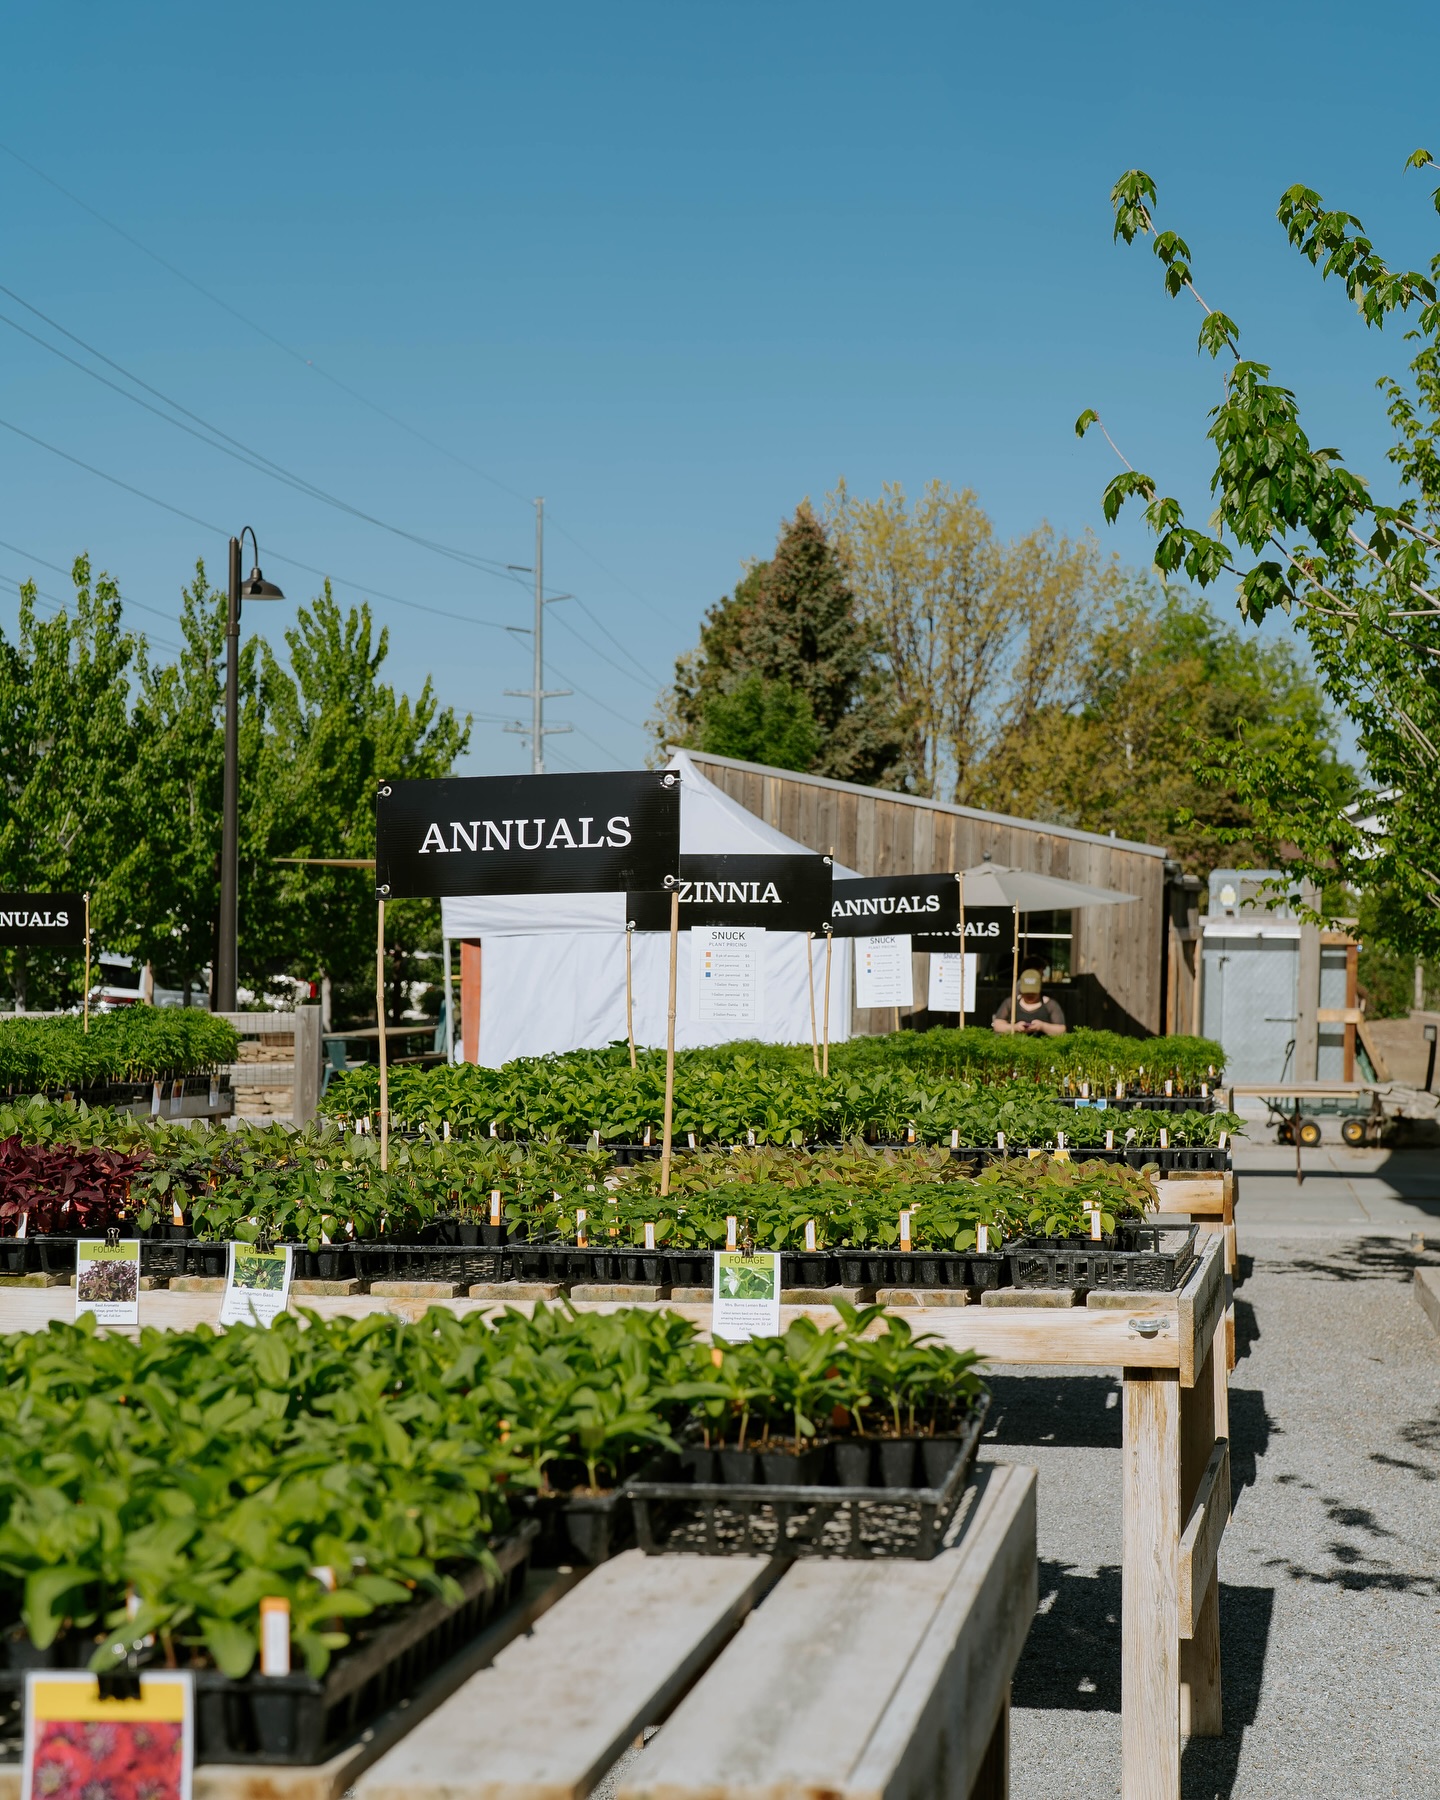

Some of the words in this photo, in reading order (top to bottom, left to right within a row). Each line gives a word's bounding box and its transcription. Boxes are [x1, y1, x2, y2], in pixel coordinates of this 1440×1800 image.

[418, 816, 632, 854] ANNUALS
[678, 882, 782, 903] ZINNIA
[832, 895, 940, 918] ANNUALS
[0, 912, 69, 927] NUALS
[712, 932, 746, 940] SNUCK
[730, 1256, 764, 1264] FOLIAGE
